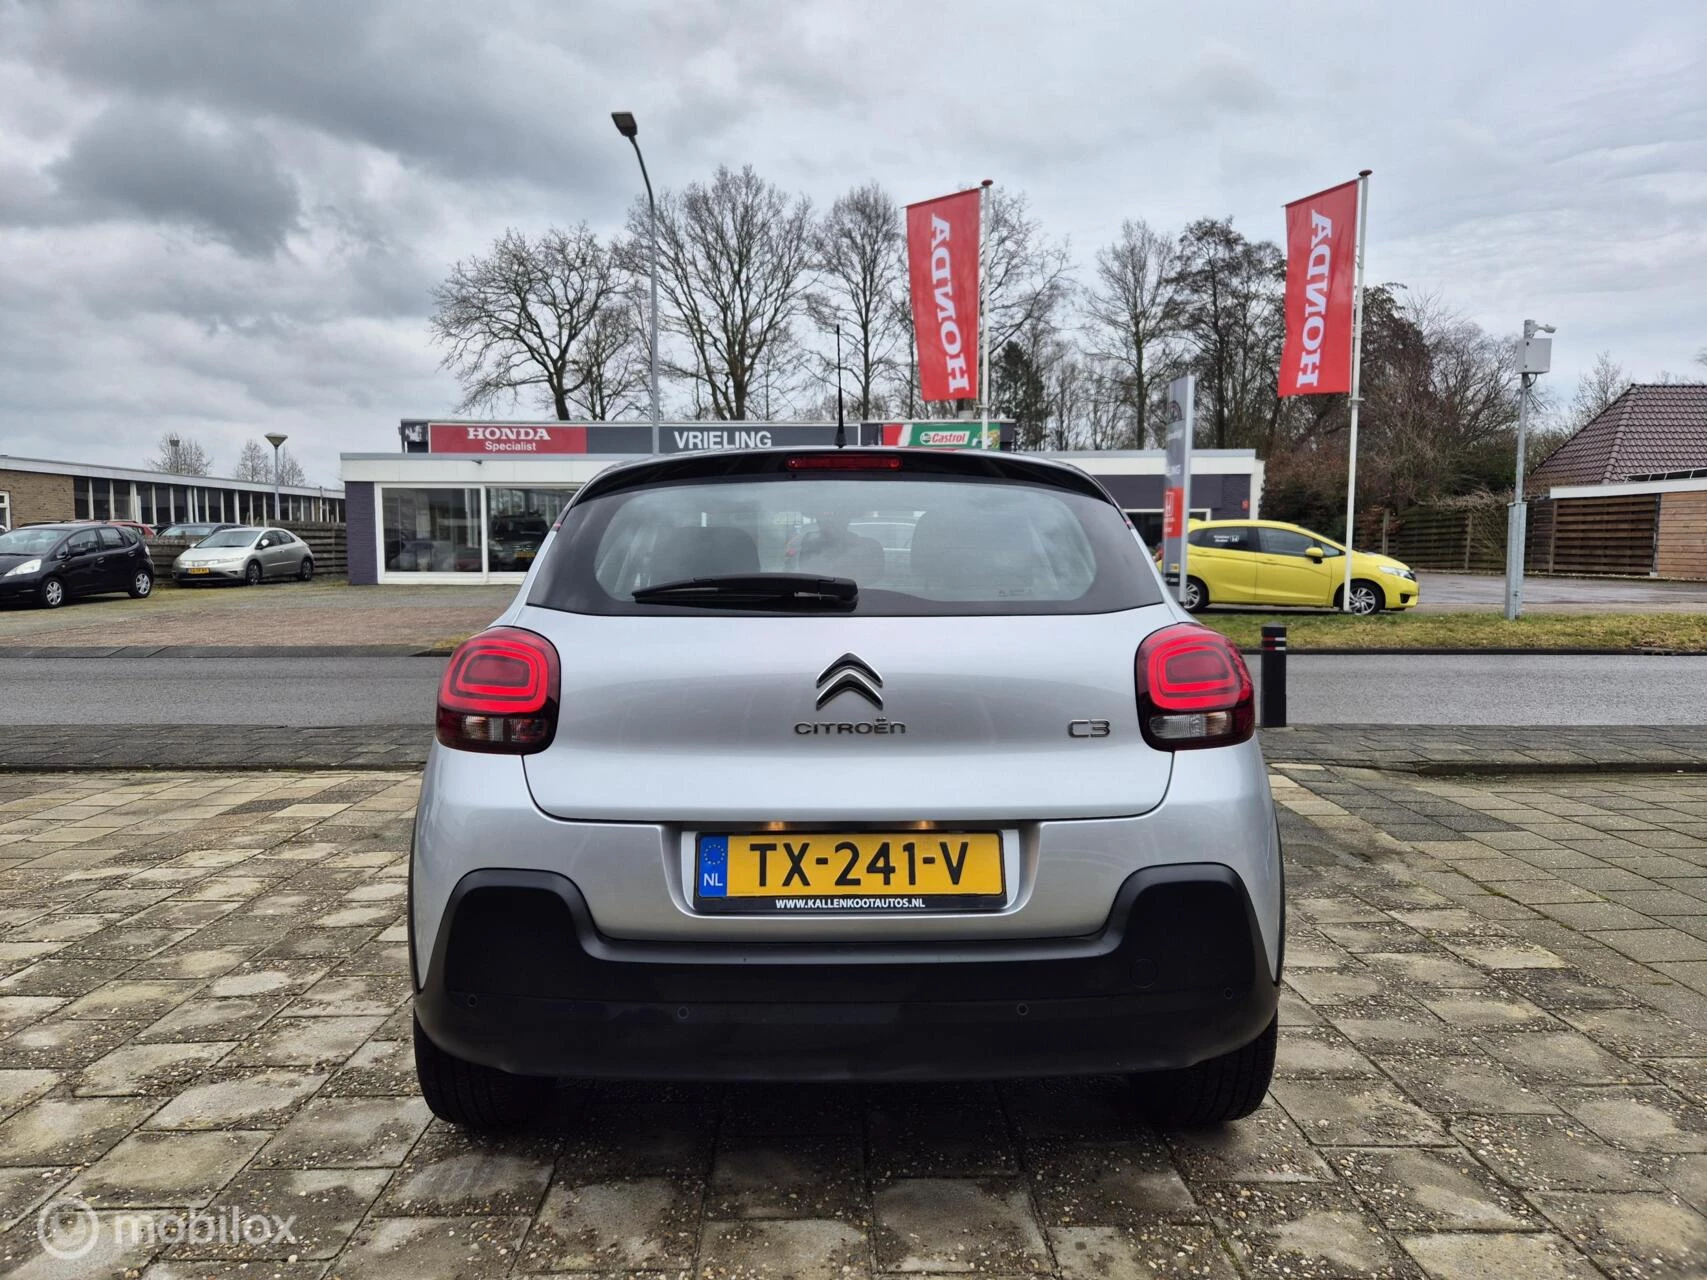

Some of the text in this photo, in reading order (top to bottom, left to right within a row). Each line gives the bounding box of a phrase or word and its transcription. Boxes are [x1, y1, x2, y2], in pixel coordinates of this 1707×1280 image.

[467, 427, 551, 440] HONDA
[673, 431, 772, 449] VRIELING
[931, 433, 966, 443] Castrol
[485, 441, 536, 452] Specialist
[1067, 719, 1111, 738] C3
[749, 841, 969, 887] TX-241-V
[703, 873, 723, 887] NL
[775, 898, 926, 910] WWW.KALLENKOOTAUTOS.NL
